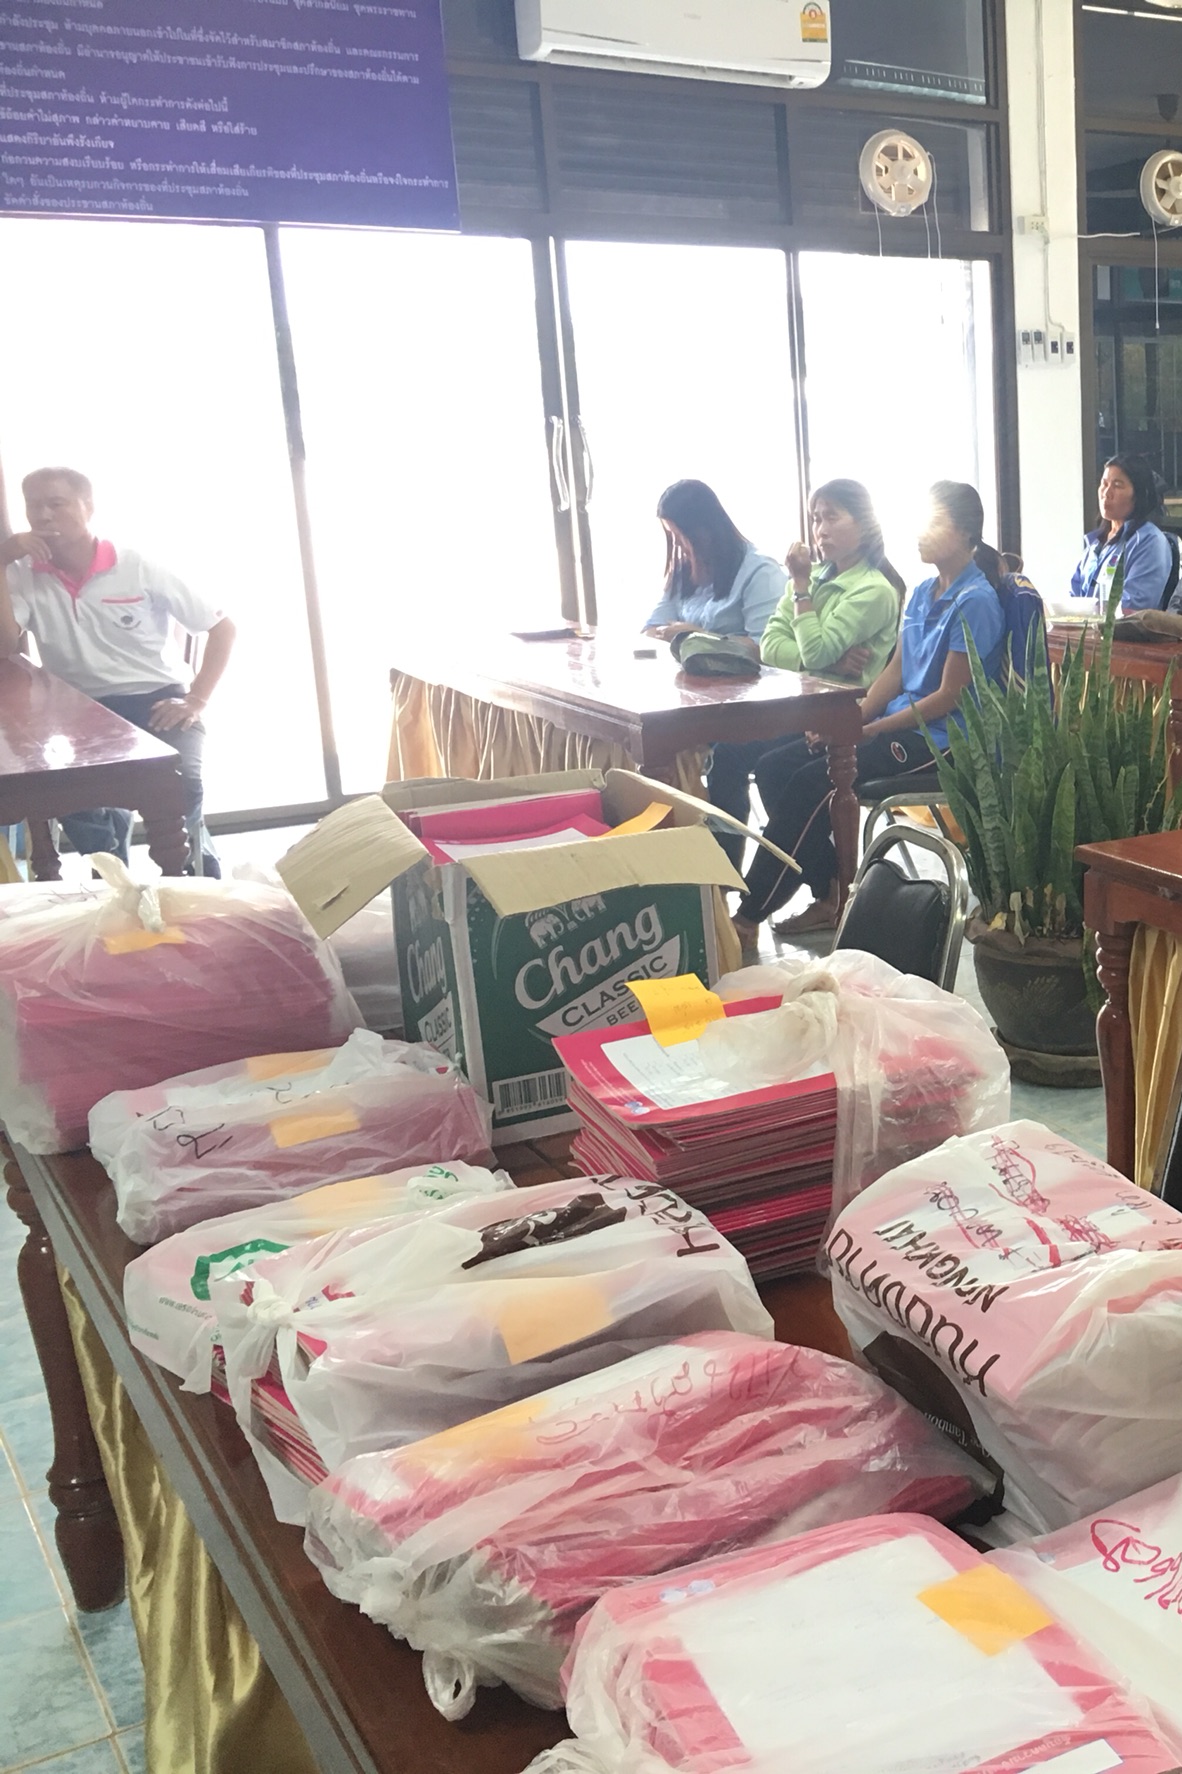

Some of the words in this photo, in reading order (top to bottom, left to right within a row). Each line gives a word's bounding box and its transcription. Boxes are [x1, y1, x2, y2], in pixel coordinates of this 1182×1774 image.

[407, 936, 448, 1003] Chang
[515, 903, 664, 1010] Chang
[561, 955, 669, 1028] CLASSIC
[605, 1002, 640, 1028] BEE
